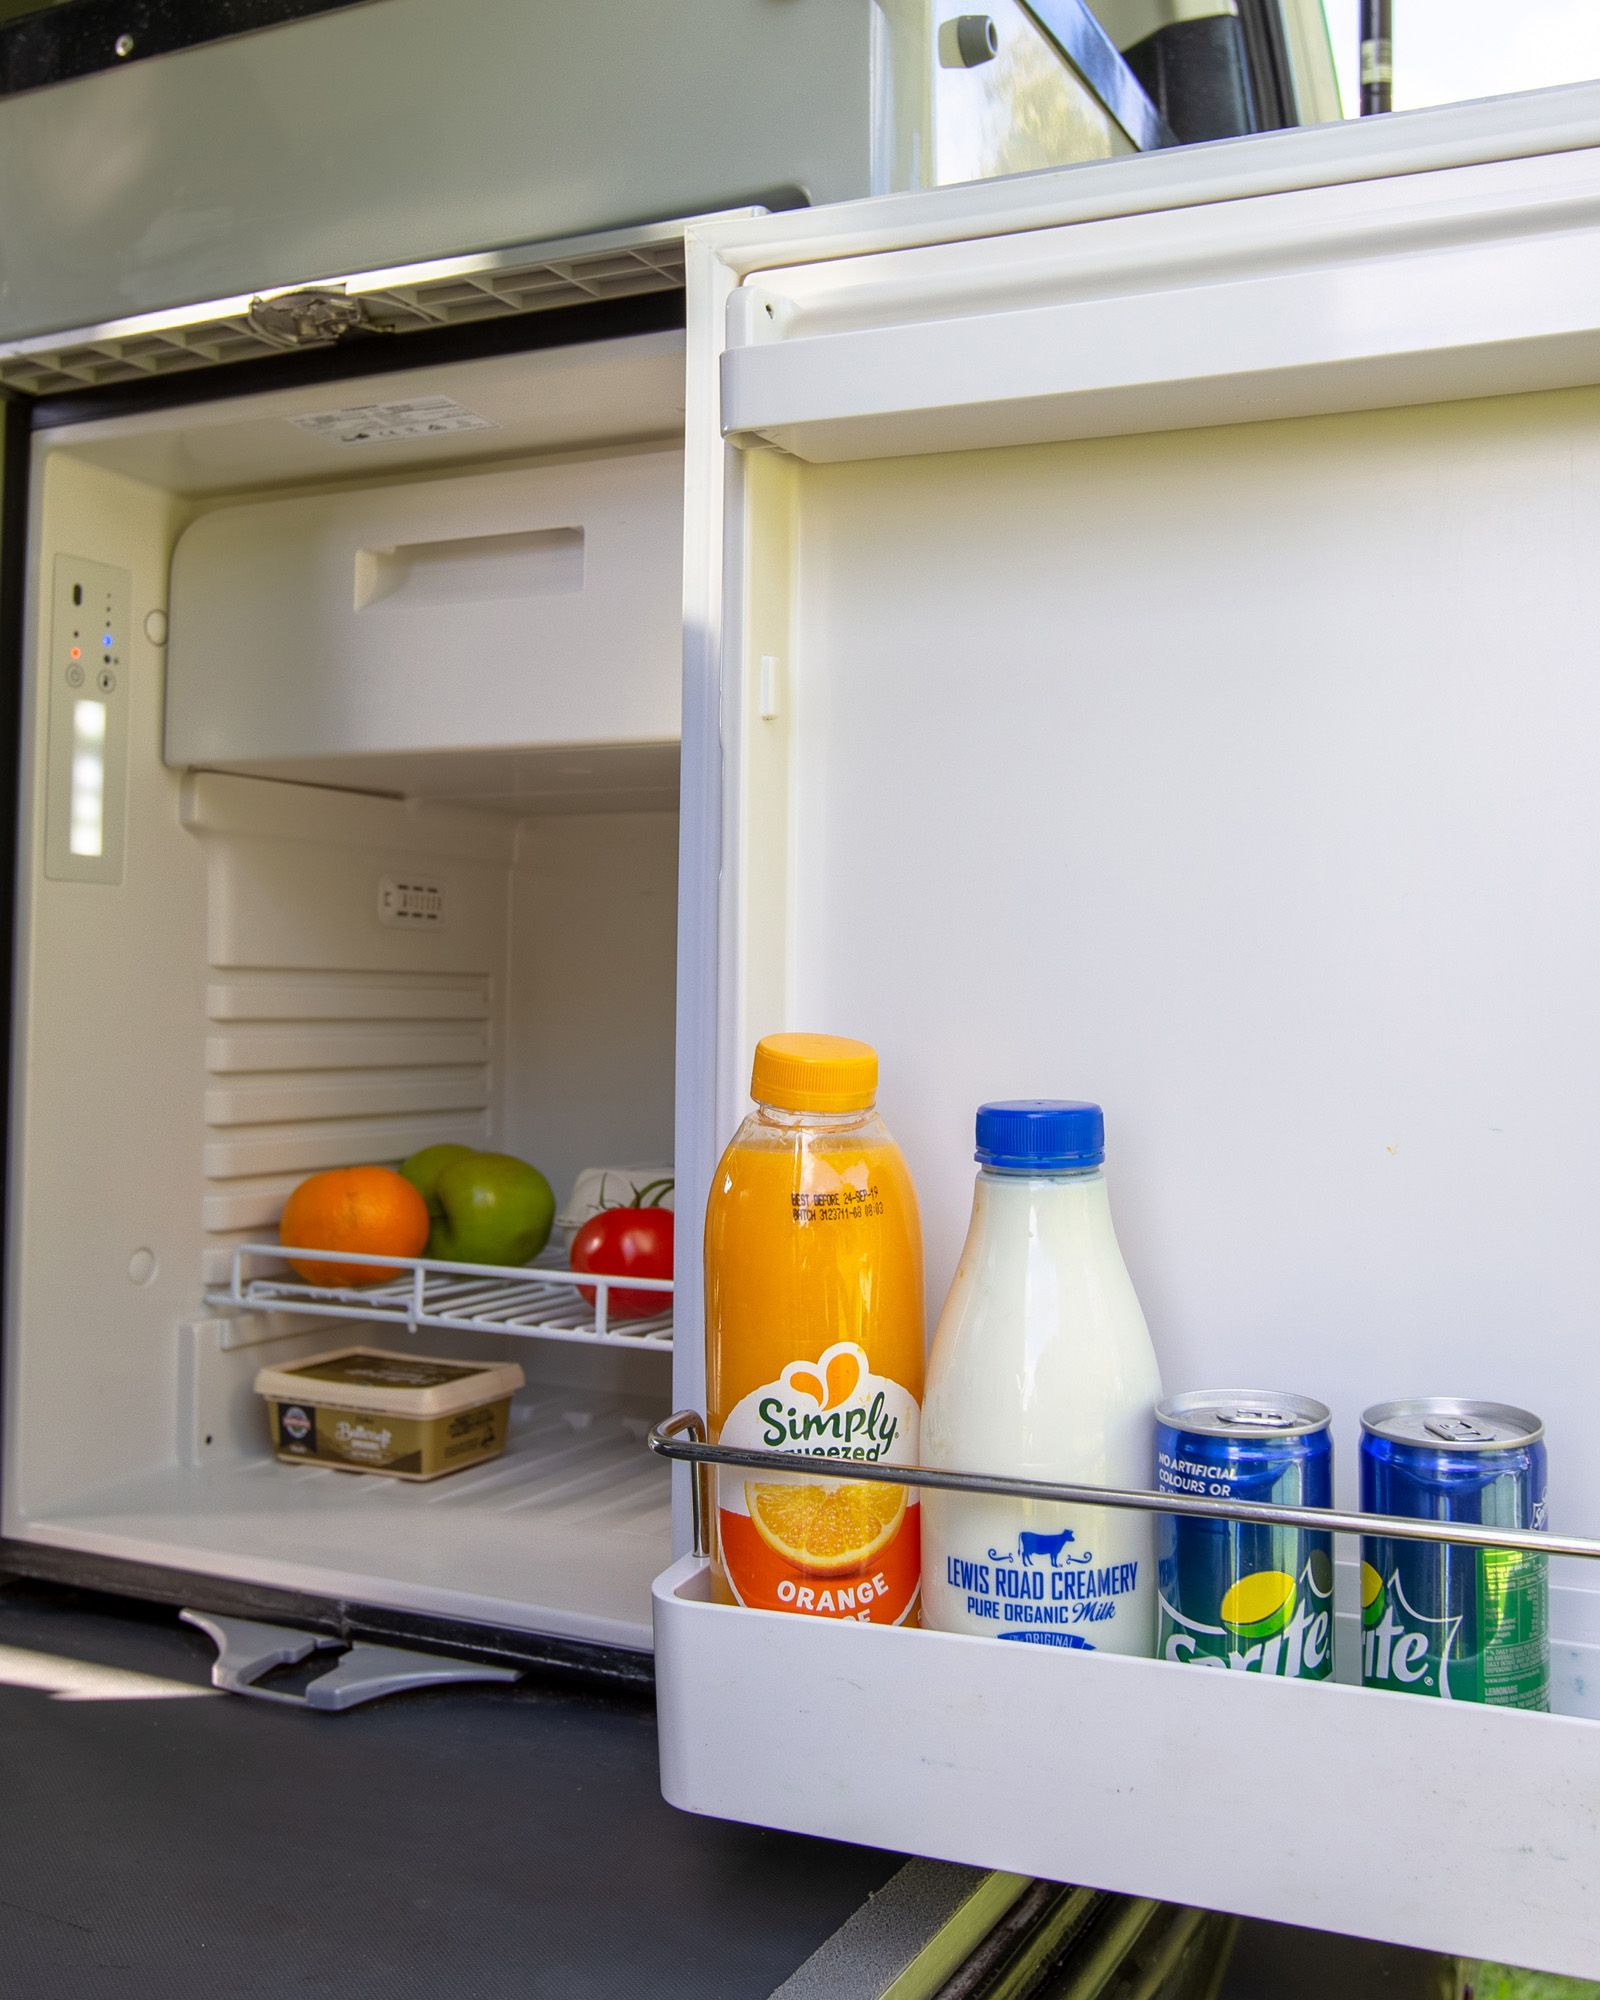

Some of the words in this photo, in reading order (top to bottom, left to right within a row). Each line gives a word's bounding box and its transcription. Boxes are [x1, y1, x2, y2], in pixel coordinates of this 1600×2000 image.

[791, 1192, 810, 1207] BEST
[813, 1192, 840, 1206] BEFORE
[792, 1208, 816, 1221] BATCH
[759, 1391, 898, 1455] Simply
[774, 1443, 881, 1462] ueezed
[1158, 1451, 1170, 1467] NO
[1170, 1459, 1238, 1481] ARTIFICIAL
[1159, 1468, 1206, 1494] COLOURS
[1209, 1483, 1232, 1497] OR
[777, 1571, 890, 1612] ORANGE
[947, 1555, 990, 1595] LEWIS
[995, 1568, 1044, 1601] ROAD
[1051, 1561, 1139, 1601] CREAMERY
[967, 1596, 1000, 1620] PURE
[1004, 1603, 1069, 1624] ORGANIC
[1071, 1600, 1116, 1624] Milk
